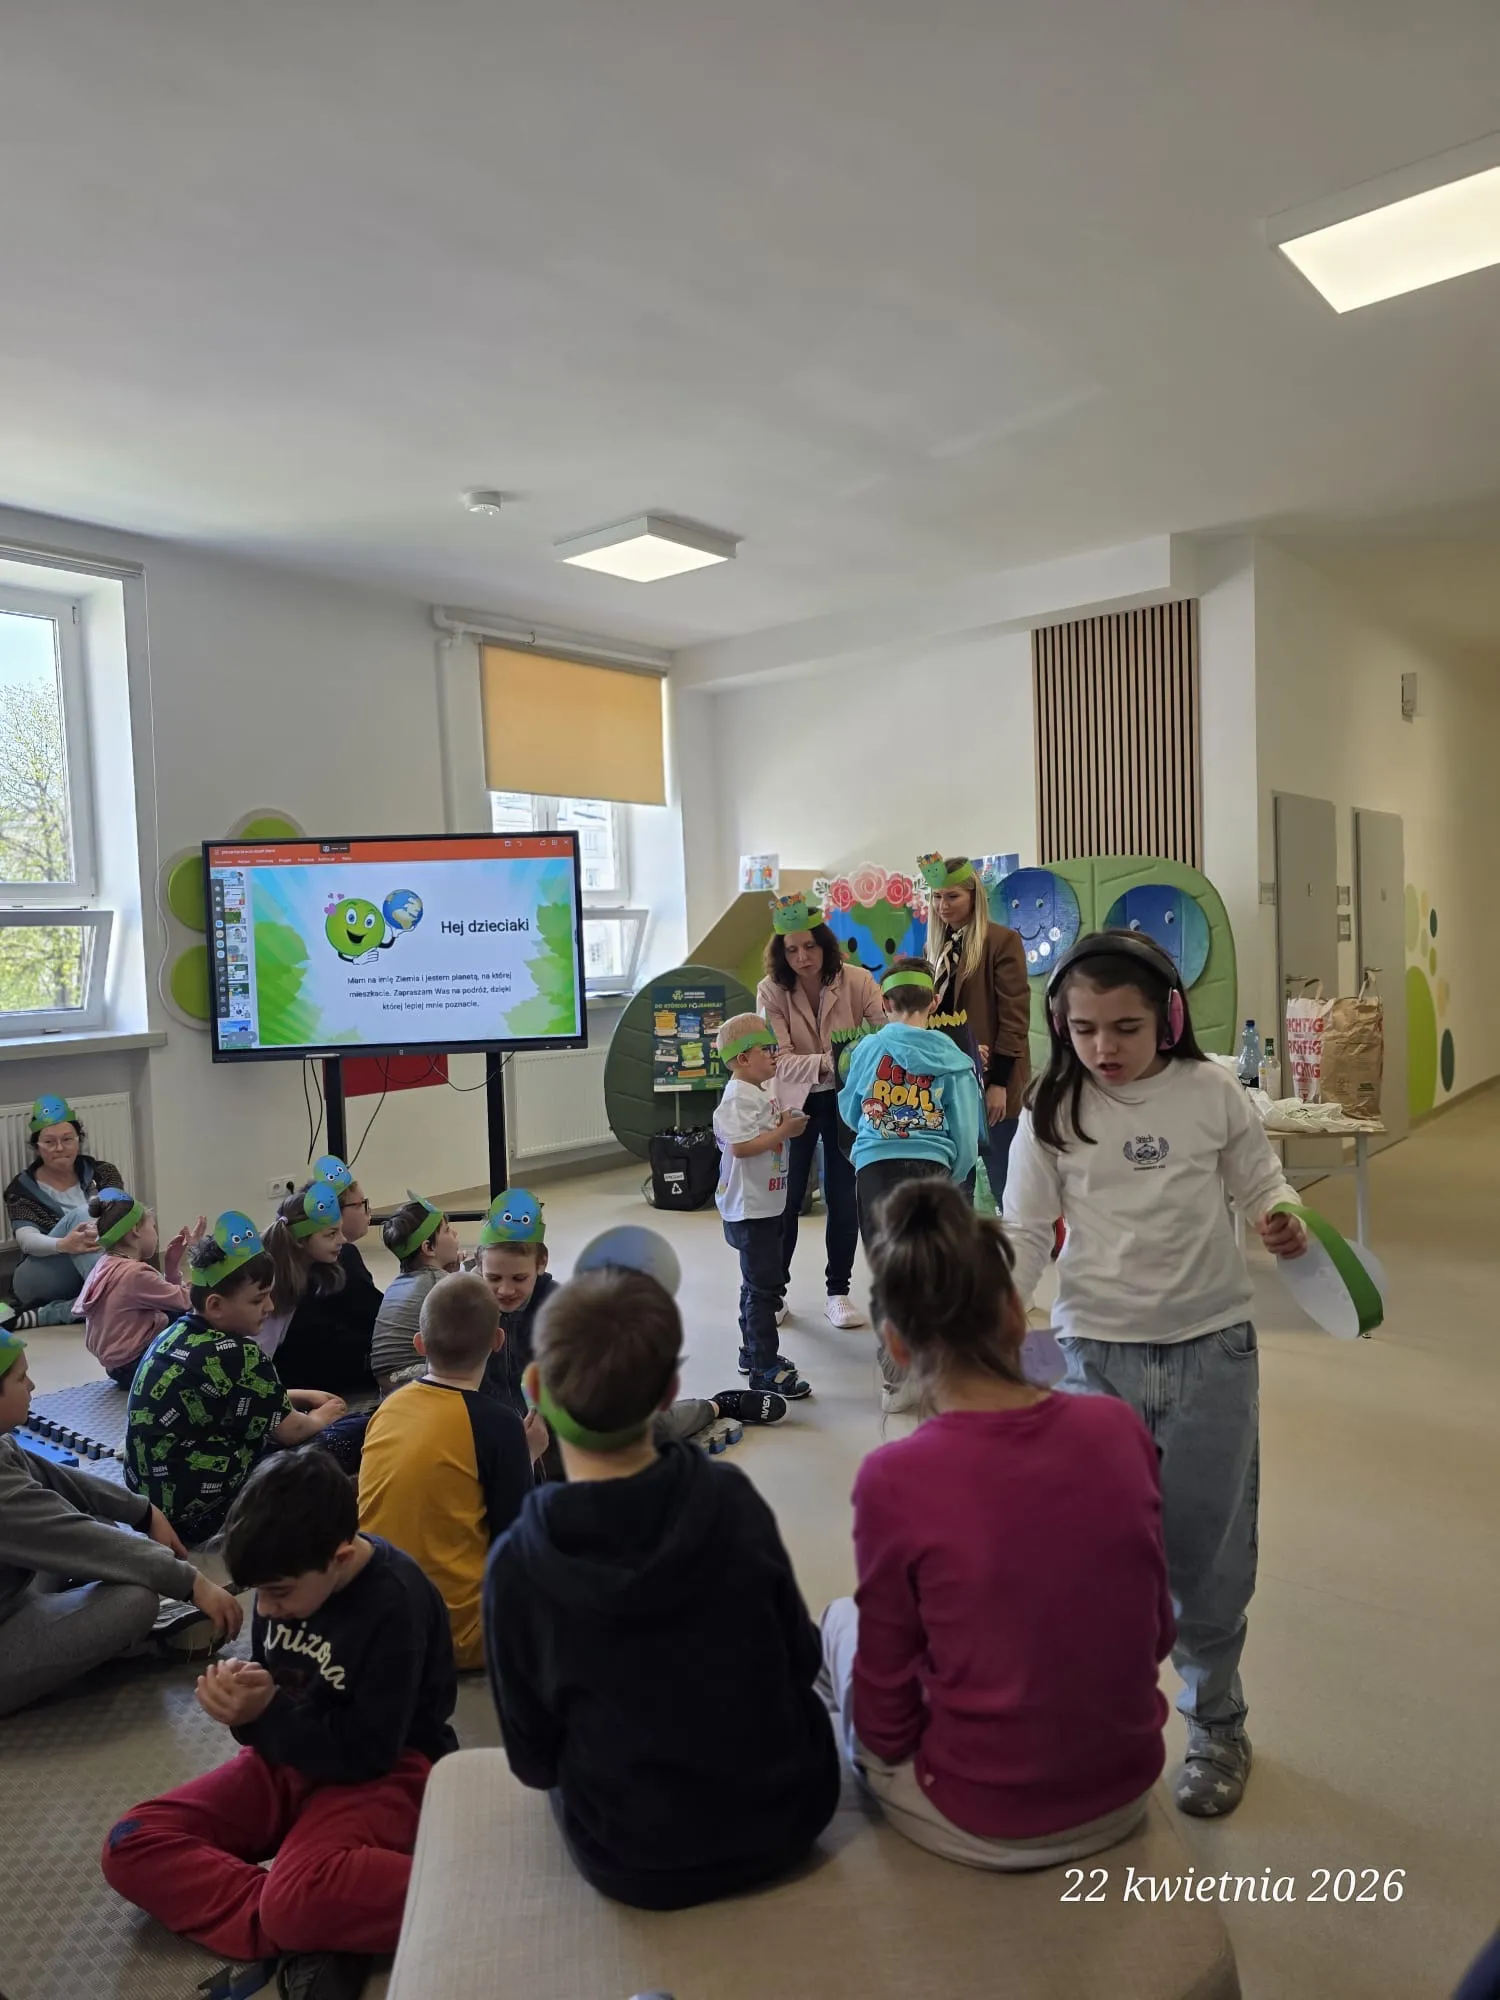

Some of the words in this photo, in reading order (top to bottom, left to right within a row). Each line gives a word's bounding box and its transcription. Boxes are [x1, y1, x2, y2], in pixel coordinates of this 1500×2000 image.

[441, 920, 464, 936] Hej
[468, 918, 529, 933] dzieciaki
[425, 974, 450, 983] jestem
[393, 989, 433, 997] Zapraszam
[404, 1002, 424, 1011] lepiej
[873, 1080, 935, 1112] ROLL
[760, 1395, 771, 1419] NASA
